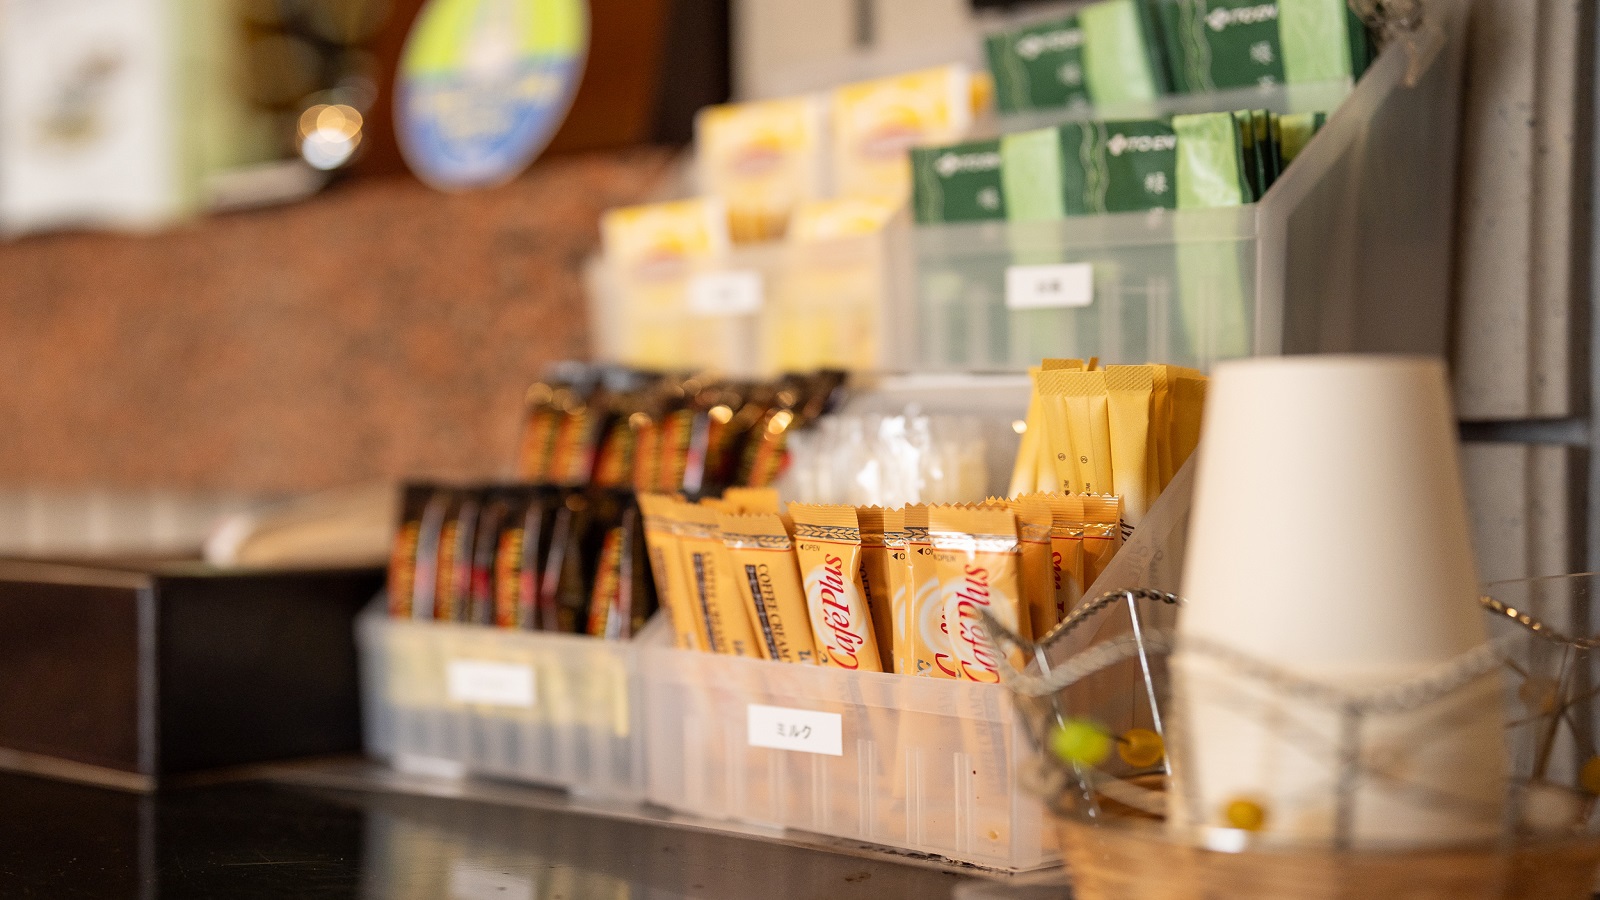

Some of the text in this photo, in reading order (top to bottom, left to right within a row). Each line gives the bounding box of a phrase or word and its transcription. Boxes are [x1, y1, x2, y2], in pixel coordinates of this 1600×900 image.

[758, 564, 778, 611] COFFEE
[777, 722, 811, 740] ミルク
